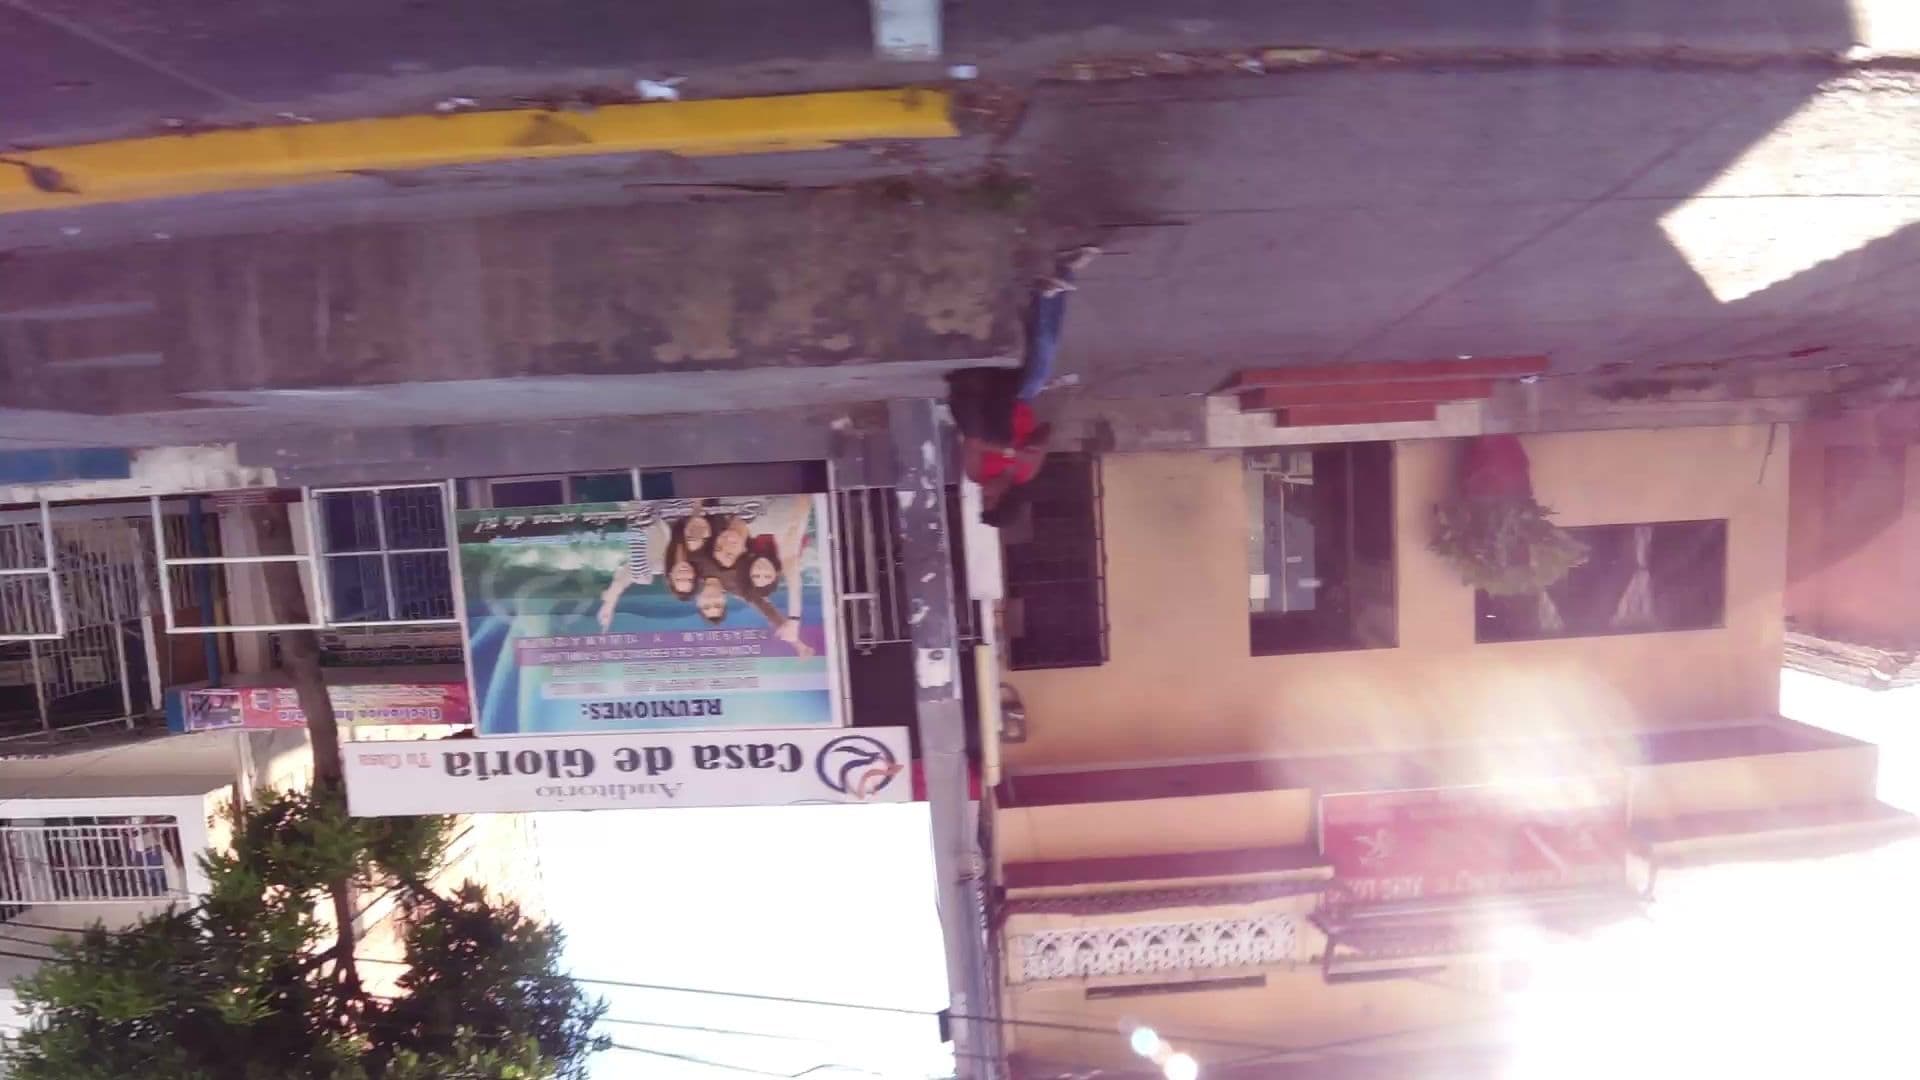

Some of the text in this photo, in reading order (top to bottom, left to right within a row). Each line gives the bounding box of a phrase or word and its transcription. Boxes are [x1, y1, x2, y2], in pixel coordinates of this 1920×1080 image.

[580, 697, 723, 721] REUNIONES:
[358, 751, 434, 771] Tu Casa
[442, 742, 803, 784] Casa de Gloria
[535, 780, 684, 803] Auditorio
